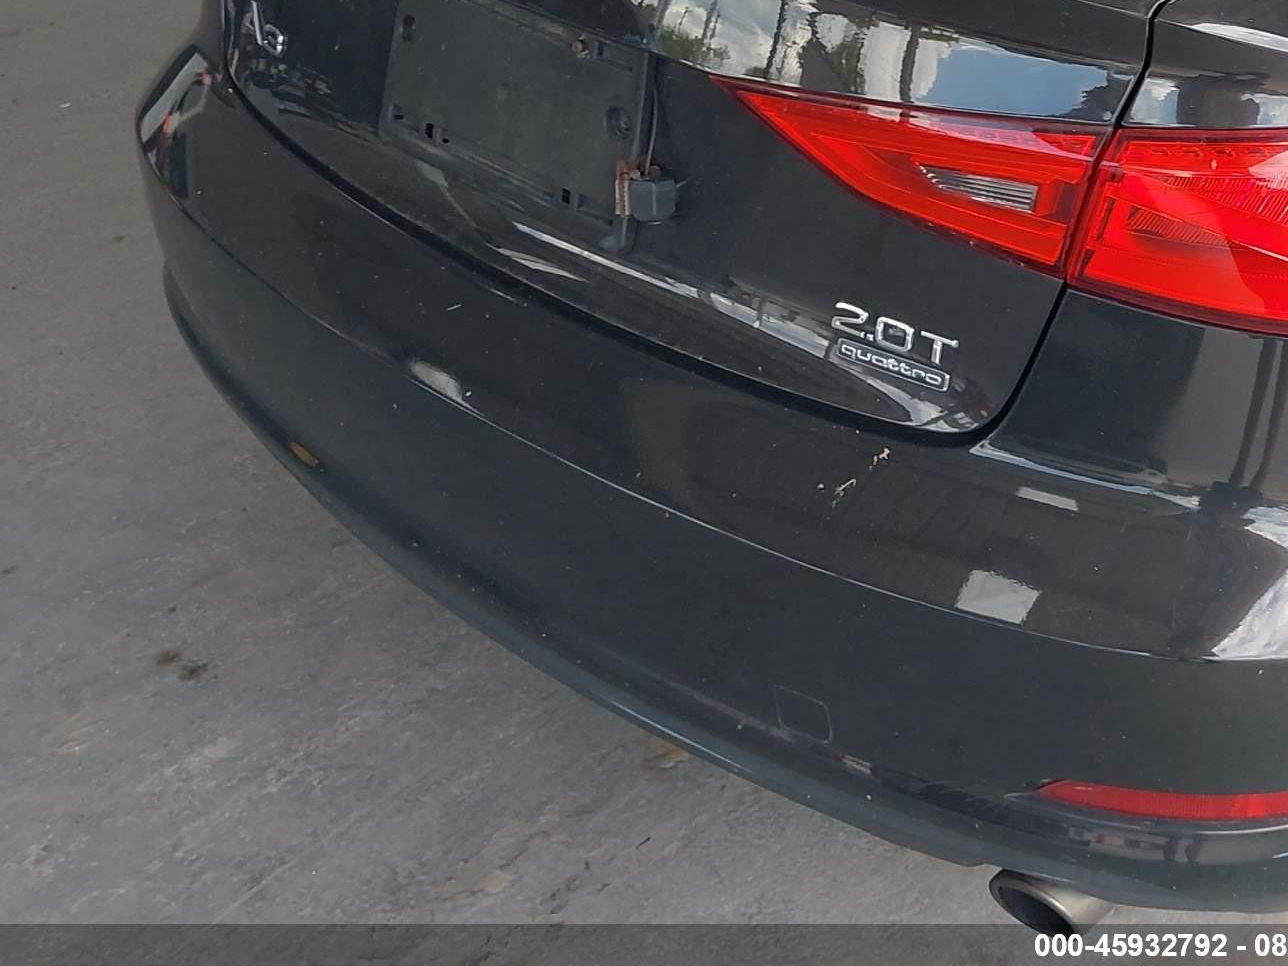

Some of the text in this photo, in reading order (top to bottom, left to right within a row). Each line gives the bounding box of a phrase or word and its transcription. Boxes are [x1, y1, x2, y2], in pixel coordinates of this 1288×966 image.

[242, 0, 285, 55] A3
[831, 302, 960, 365] 2.0T
[840, 343, 944, 386] quattro
